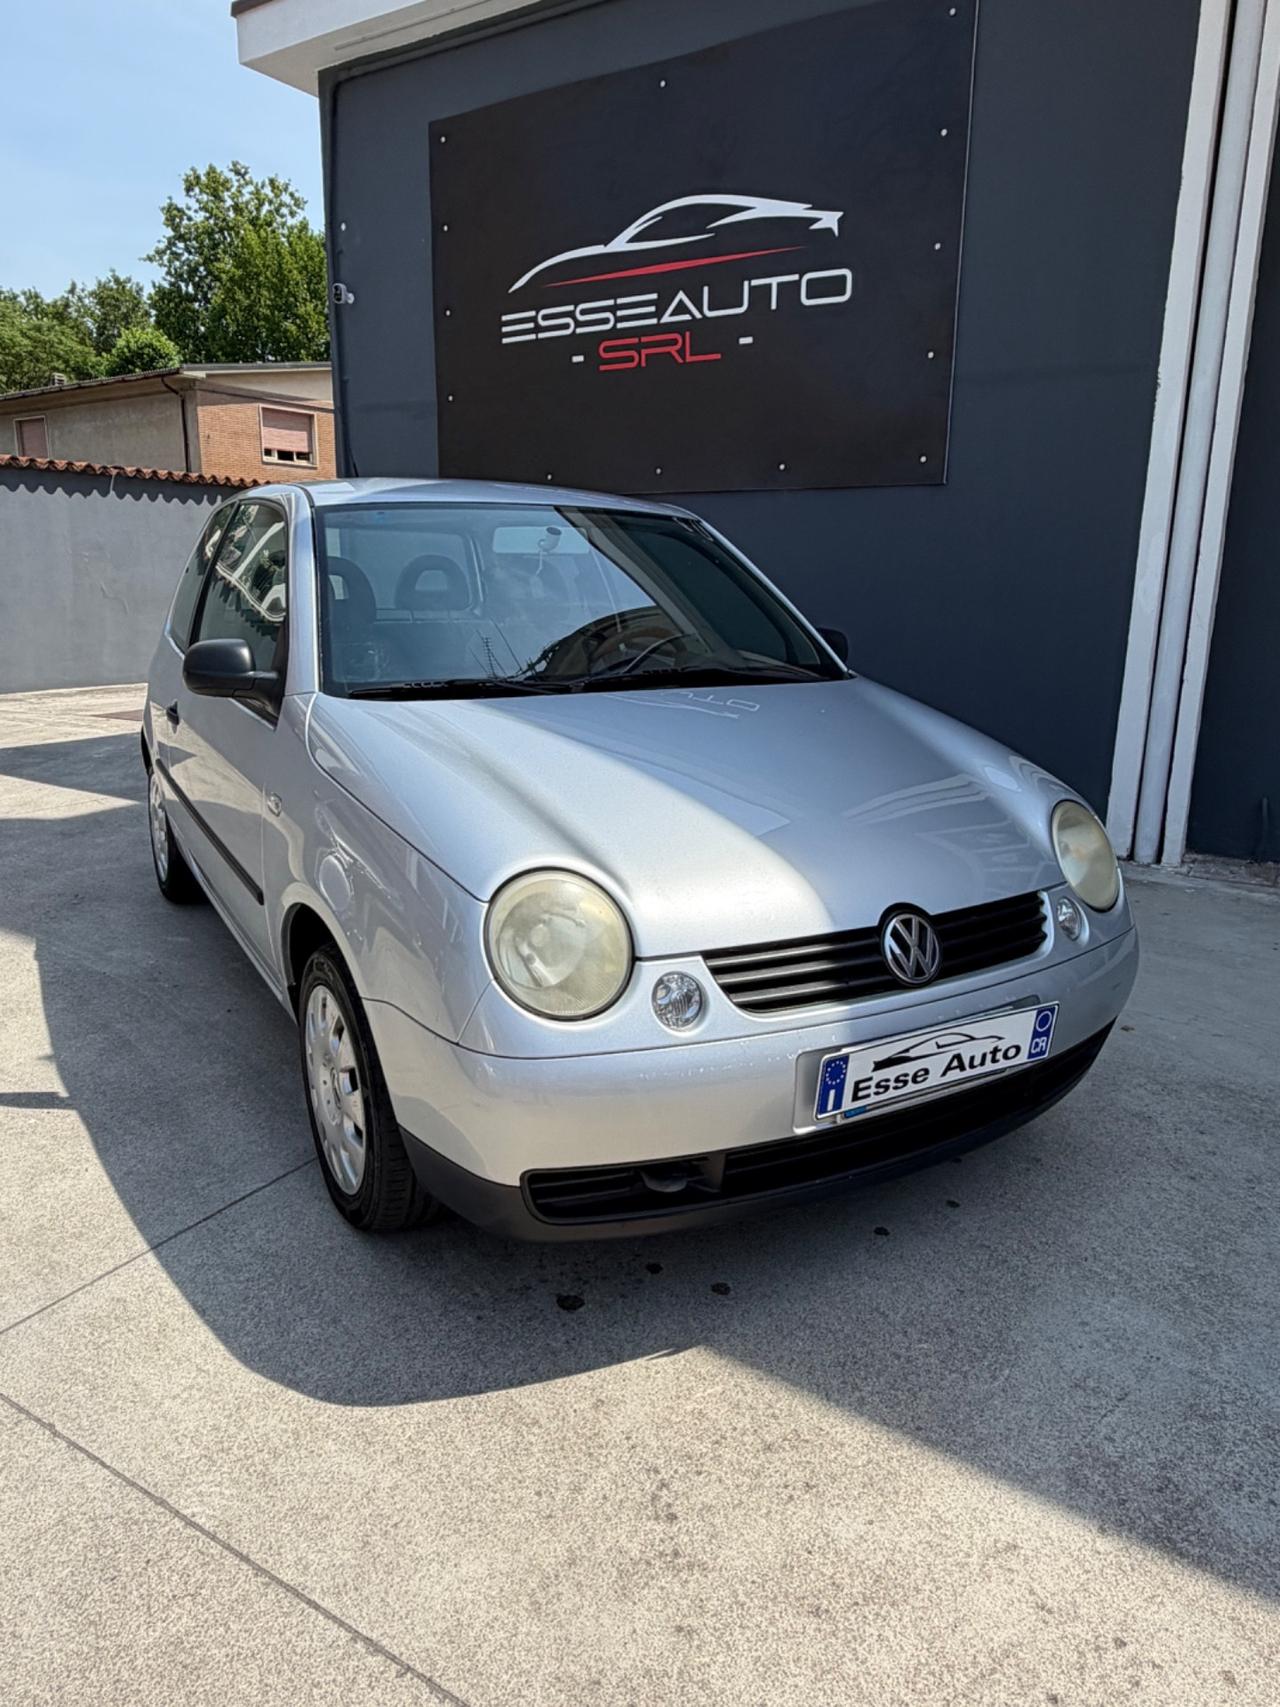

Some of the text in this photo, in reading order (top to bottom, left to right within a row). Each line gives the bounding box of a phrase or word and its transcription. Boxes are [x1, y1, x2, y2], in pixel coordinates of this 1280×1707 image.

[501, 268, 852, 344] ESSEAUTO
[599, 331, 721, 371] SRL
[884, 914, 940, 983] VW
[1031, 1036, 1047, 1053] CR
[851, 1043, 1022, 1103] Esse Auto
[827, 1089, 835, 1111] I
